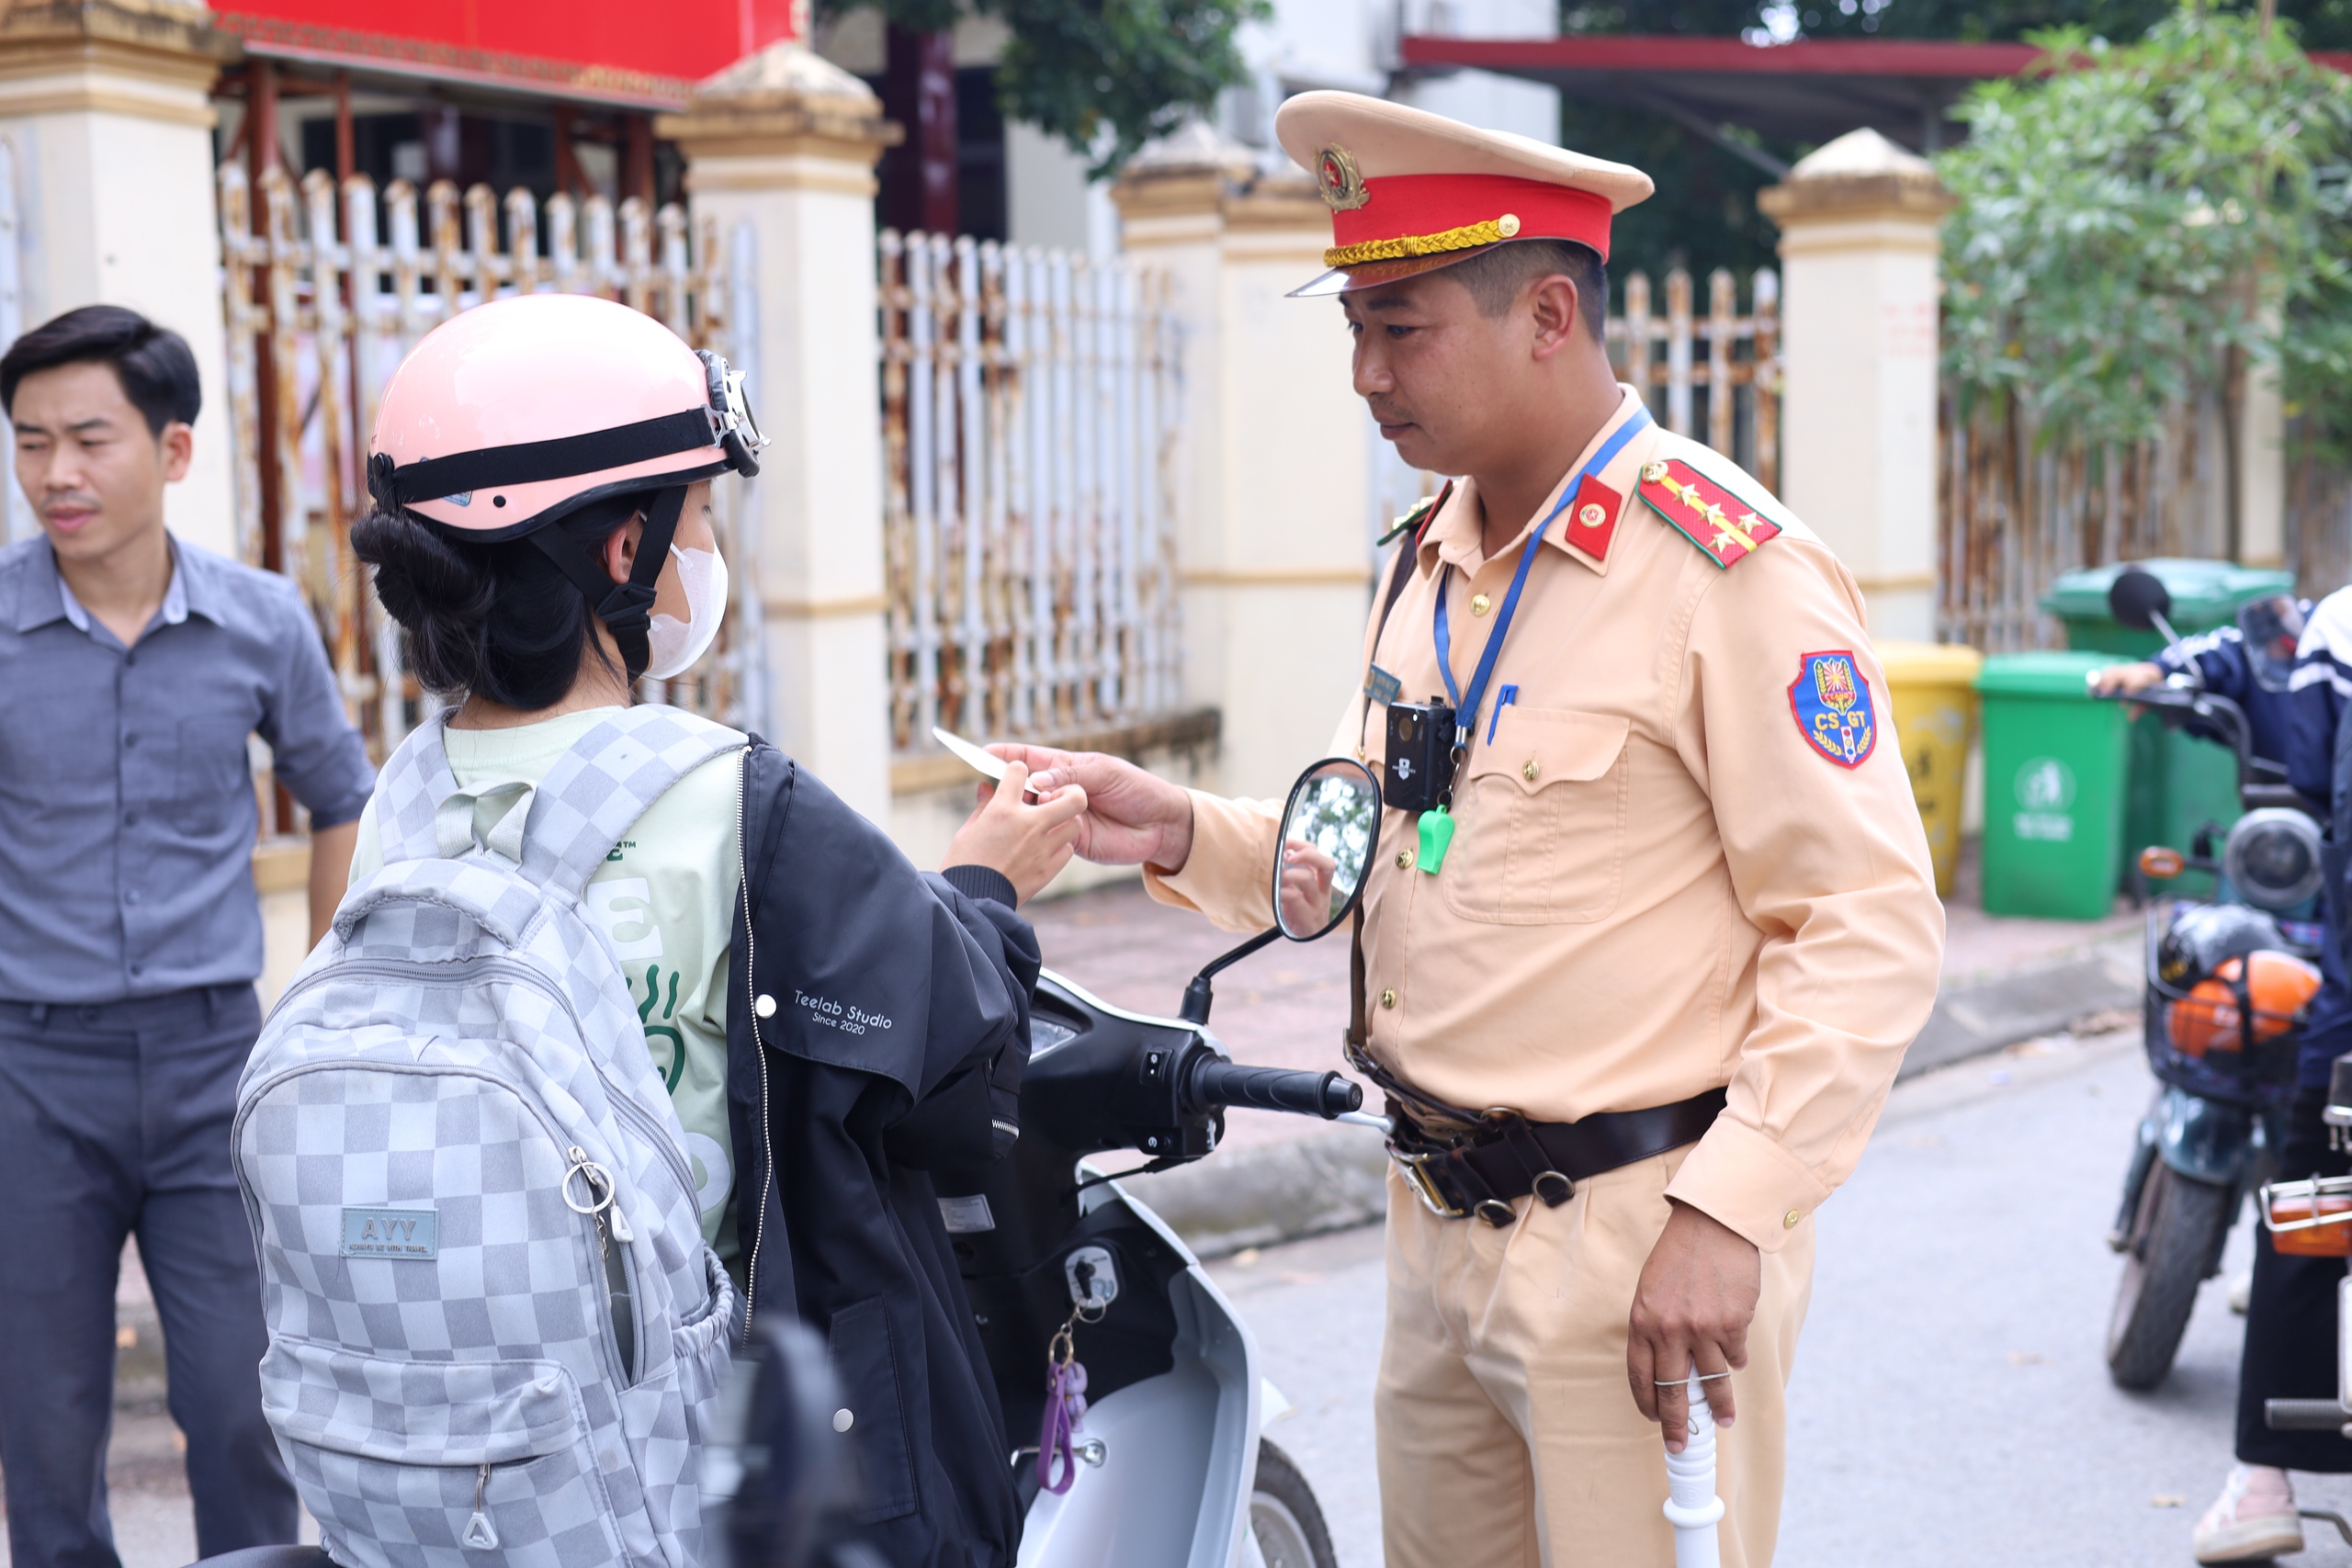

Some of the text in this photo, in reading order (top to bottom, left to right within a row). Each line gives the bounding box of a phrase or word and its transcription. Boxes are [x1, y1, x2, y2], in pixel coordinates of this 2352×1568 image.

[1815, 710, 1866, 730] CS GT
[795, 989, 892, 1030] Teelab Studio
[811, 1011, 865, 1035] Since 2020
[362, 1217, 416, 1240] AYY
